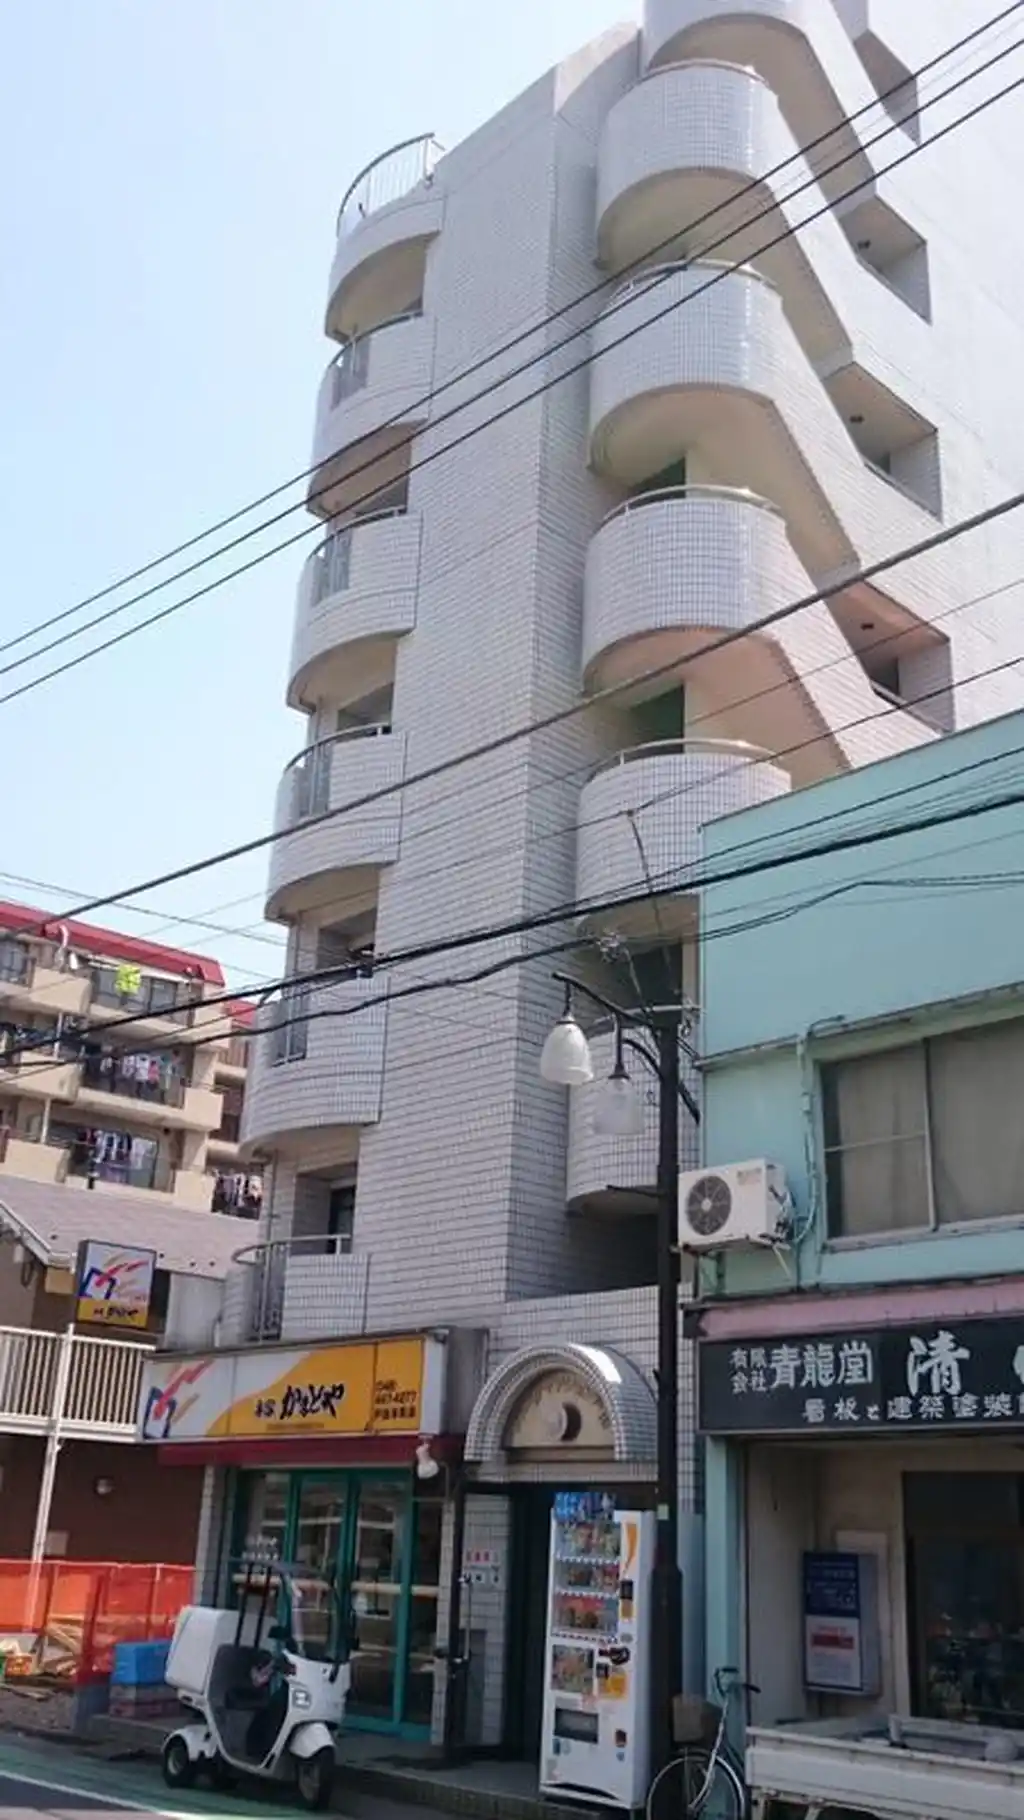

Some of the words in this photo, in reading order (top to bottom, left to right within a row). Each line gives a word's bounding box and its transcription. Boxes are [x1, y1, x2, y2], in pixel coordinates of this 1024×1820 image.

[729, 1347, 767, 1369] 有限
[769, 1340, 874, 1390] 青龍堂
[730, 1370, 767, 1394] 会社
[802, 1391, 1024, 1424] 看板と建築塗装
